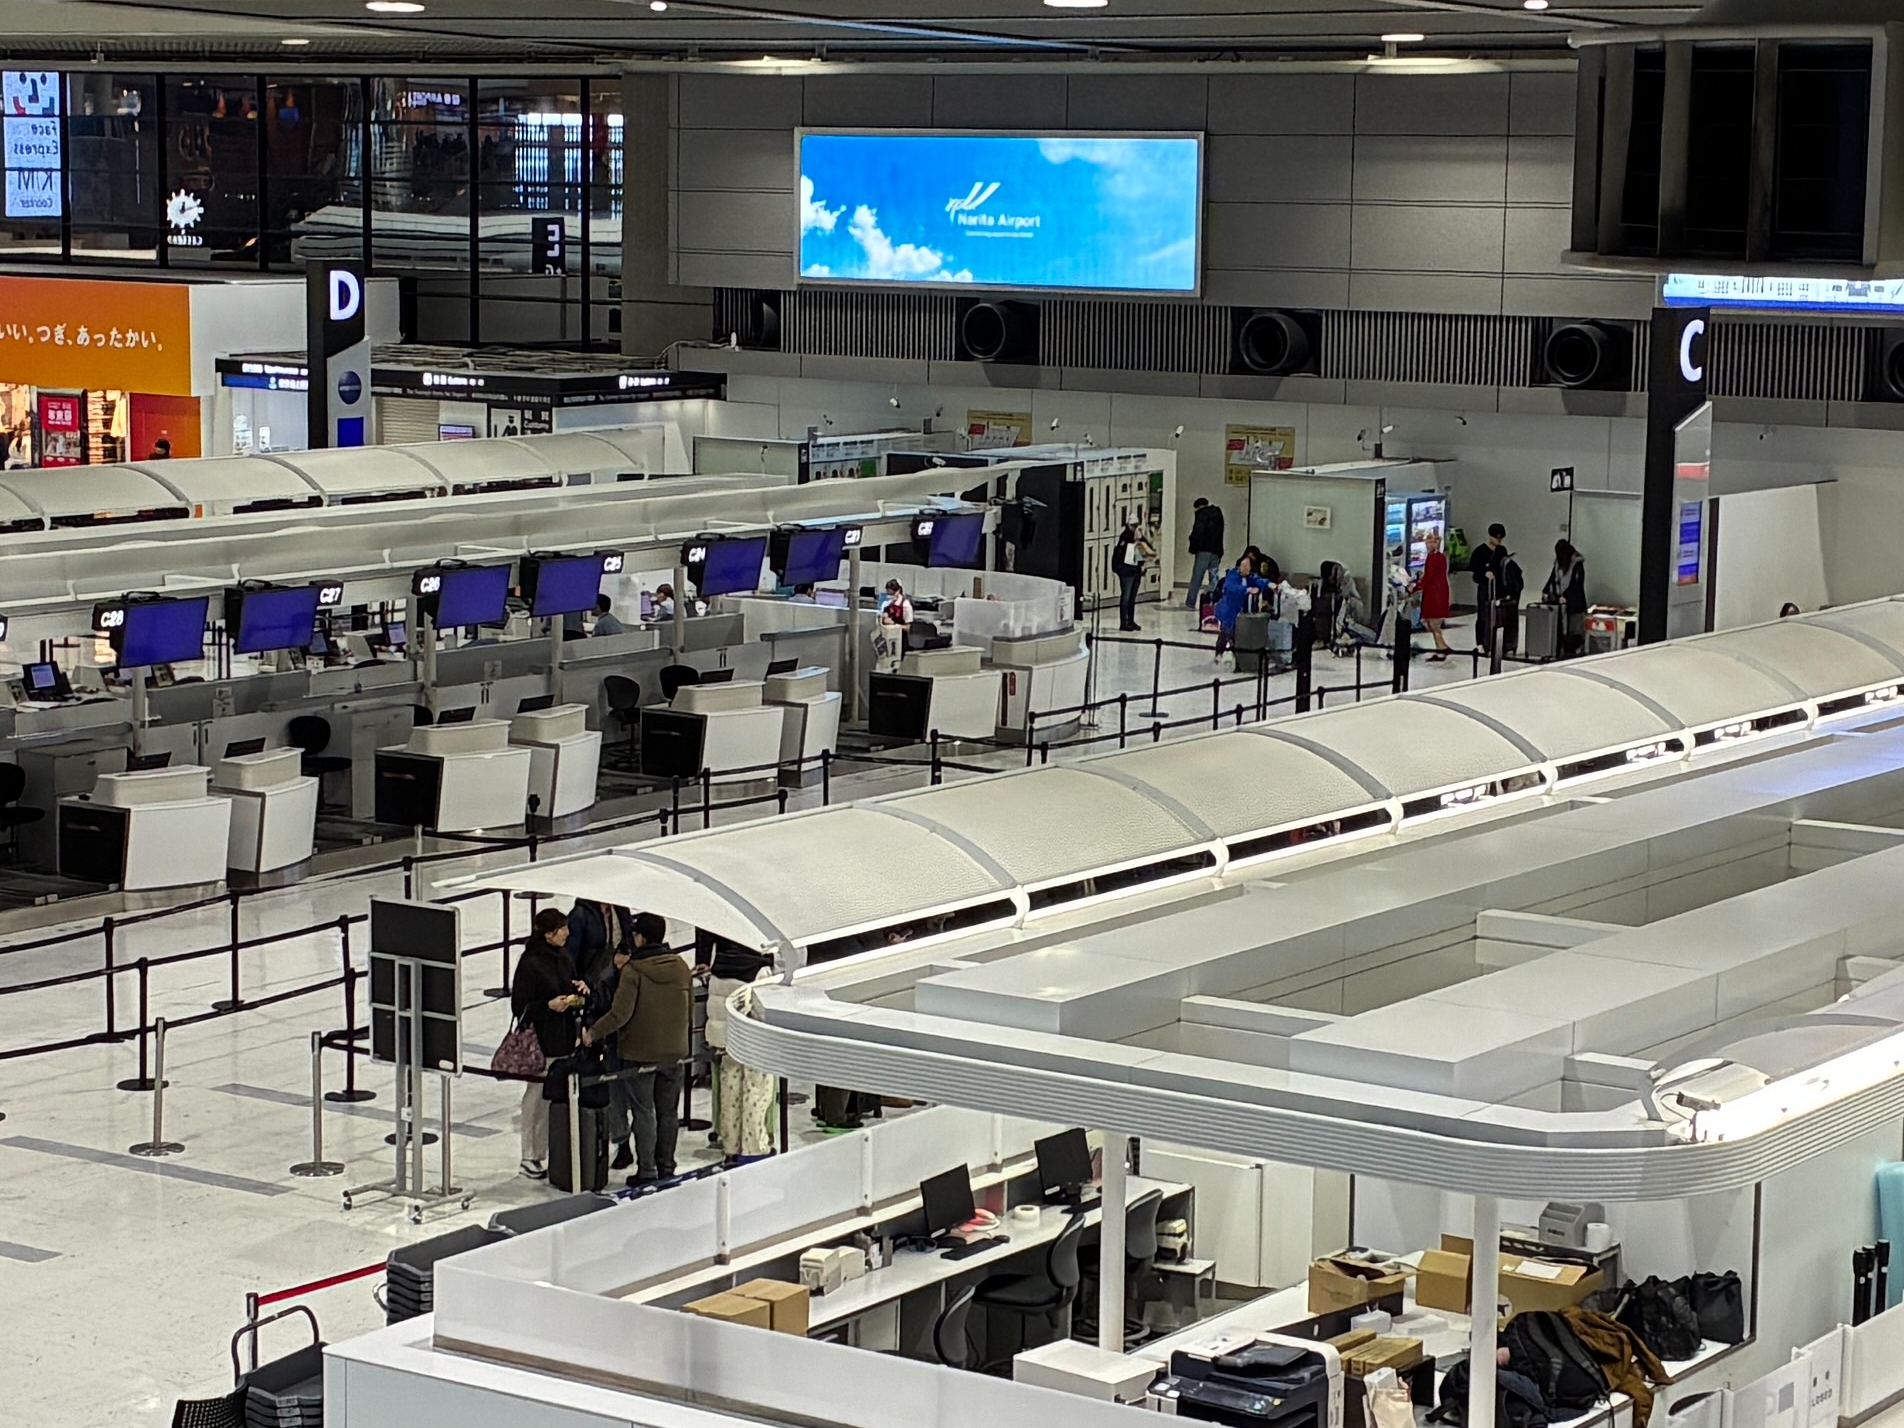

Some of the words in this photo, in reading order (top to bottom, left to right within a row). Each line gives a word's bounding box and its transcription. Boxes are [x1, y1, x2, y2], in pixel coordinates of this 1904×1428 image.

[958, 213, 995, 226] Narita
[997, 213, 1040, 230] Airport
[329, 270, 360, 321] D
[1680, 319, 1705, 382] C
[320, 588, 341, 603] C27
